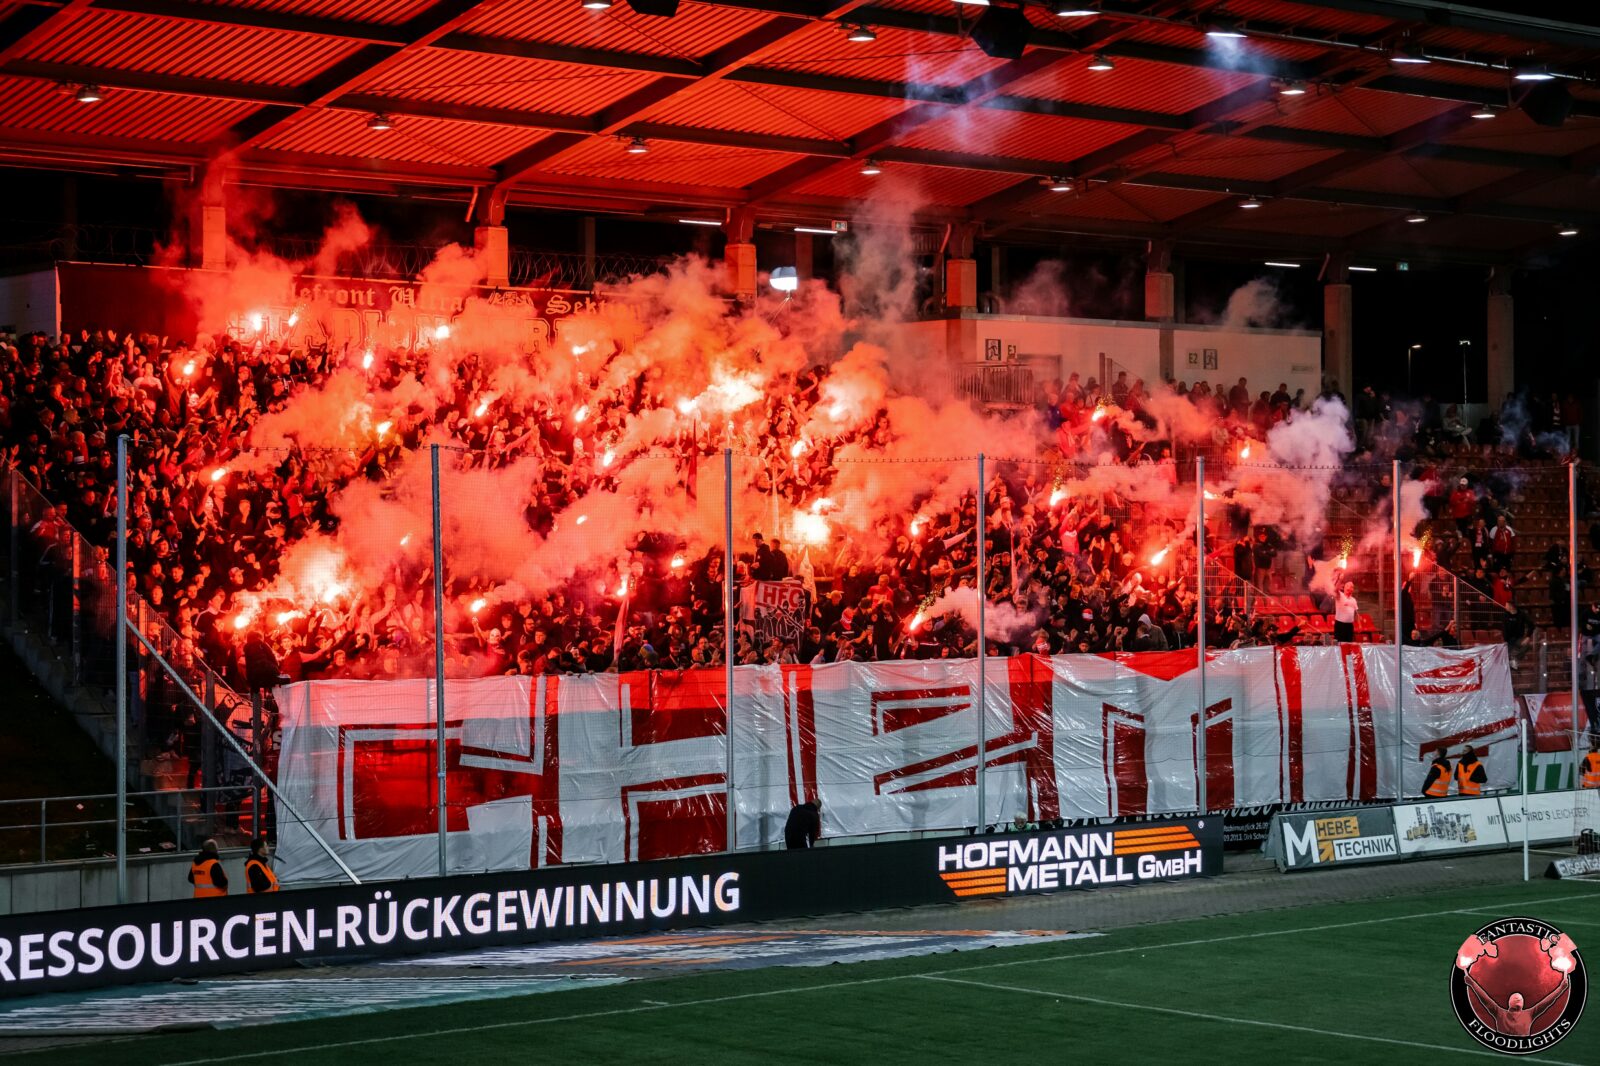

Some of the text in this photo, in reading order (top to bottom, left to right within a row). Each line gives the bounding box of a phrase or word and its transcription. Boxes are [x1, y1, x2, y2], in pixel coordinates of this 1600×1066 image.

[1317, 820, 1358, 837] HEBE-
[1487, 814, 1501, 826] MIT
[1506, 812, 1521, 824] UNS
[1552, 807, 1591, 820] LEICHTER
[938, 831, 1114, 871] HOFMANN
[1335, 837, 1395, 857] TECHNIK
[1008, 857, 1134, 892] METALL
[0, 871, 741, 981] RESSOURCEN-RÜCKGEWINNUNG
